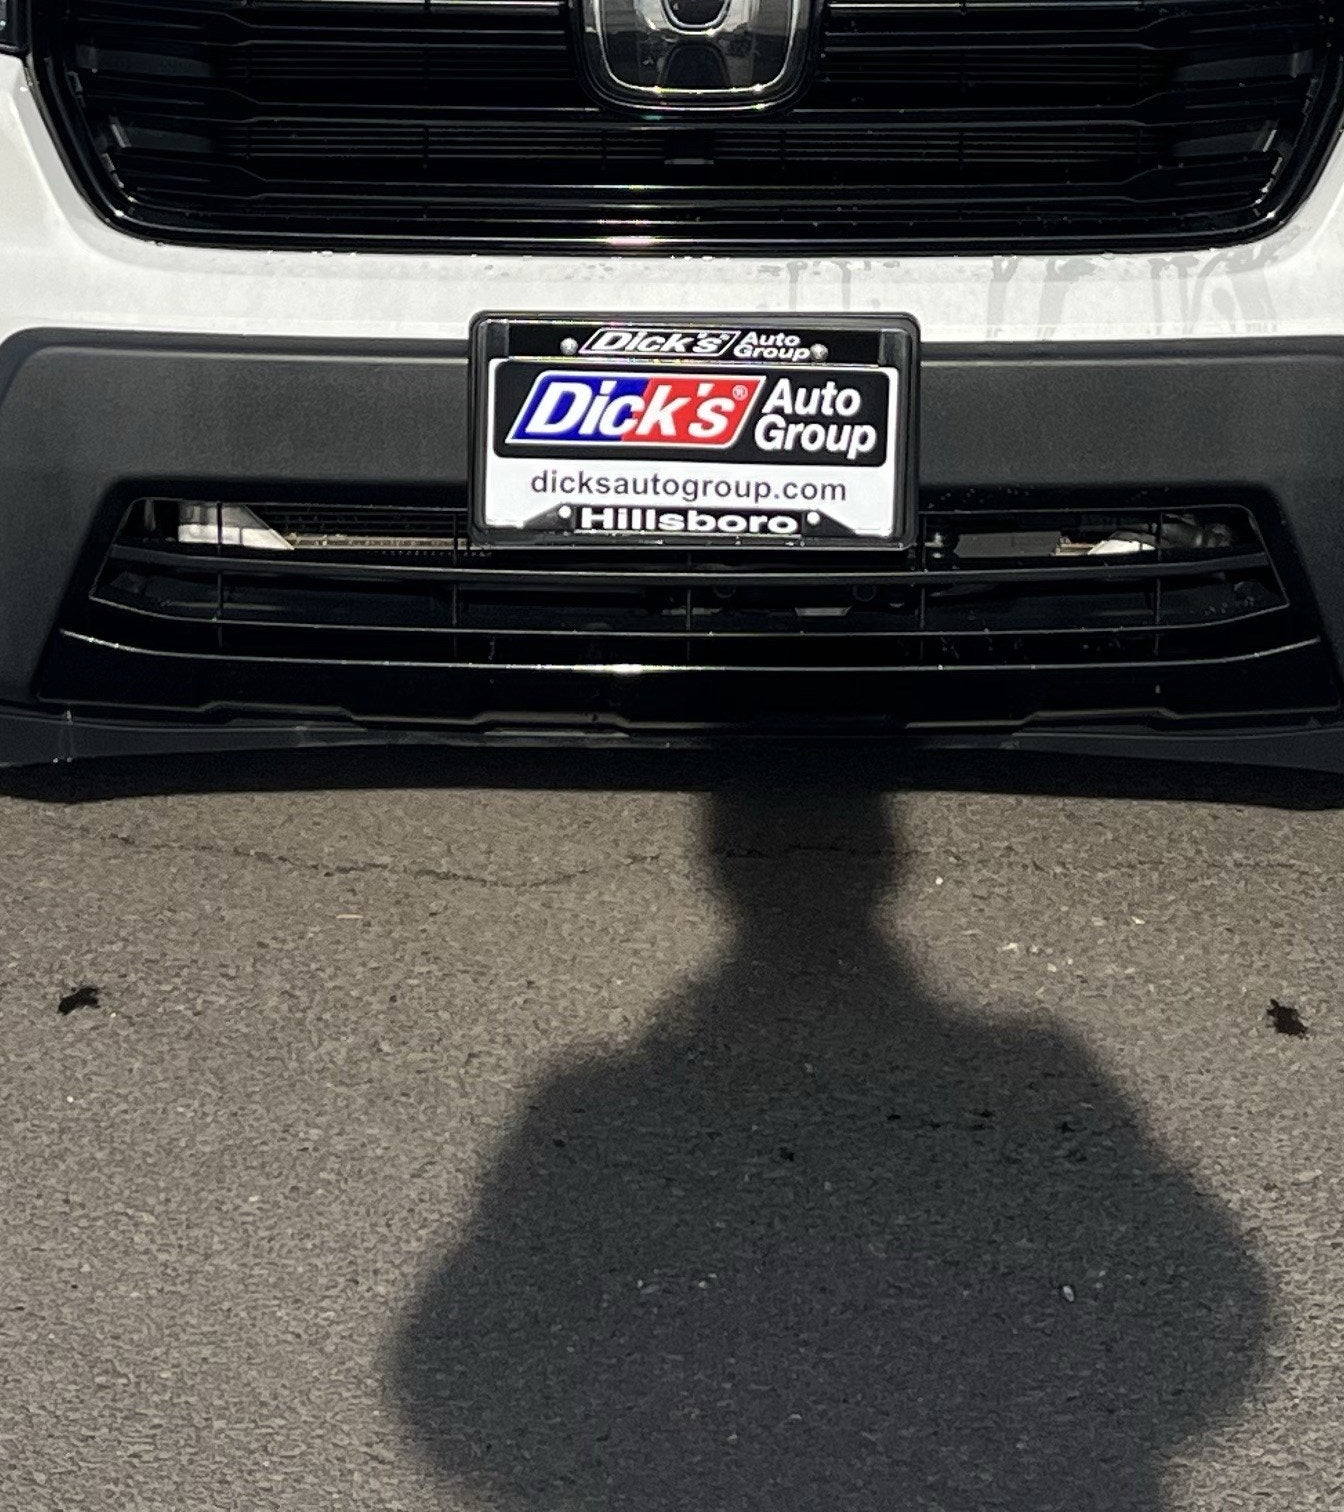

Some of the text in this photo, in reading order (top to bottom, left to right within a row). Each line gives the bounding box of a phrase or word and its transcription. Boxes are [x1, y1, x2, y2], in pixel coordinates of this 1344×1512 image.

[733, 343, 811, 362] Group
[742, 330, 801, 347] Auto
[523, 377, 862, 440] Dick's Auto
[754, 414, 877, 460] Group
[530, 469, 848, 504] dicksautogroup.com
[580, 506, 799, 534] Hillsboro
